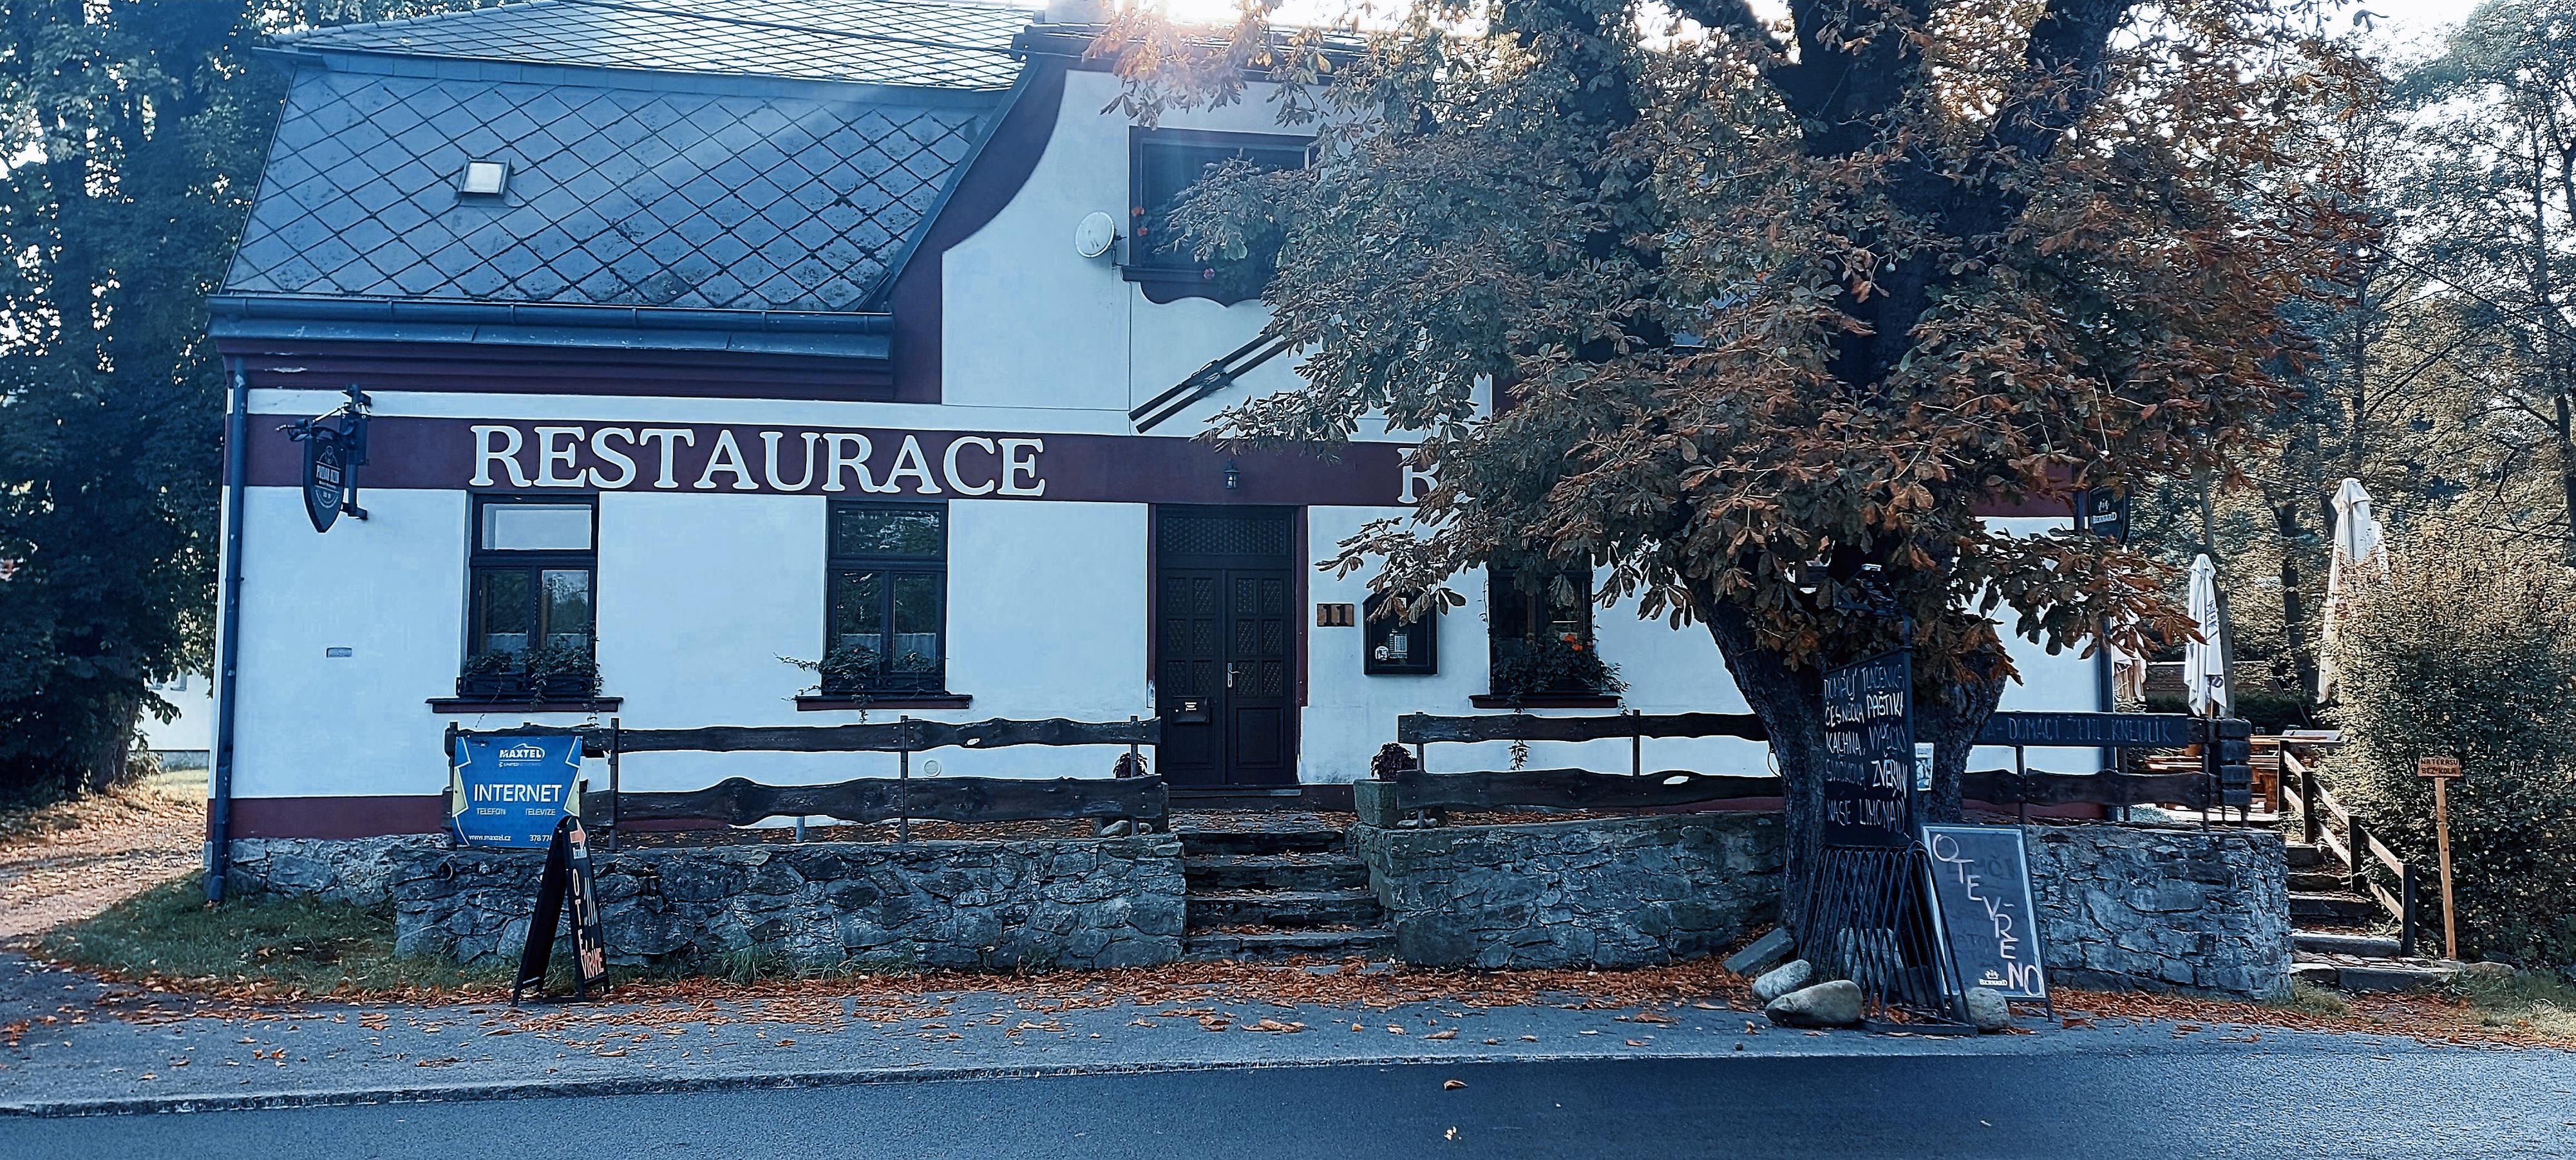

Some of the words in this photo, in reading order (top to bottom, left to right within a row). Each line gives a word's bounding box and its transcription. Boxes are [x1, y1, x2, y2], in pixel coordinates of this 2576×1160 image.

[469, 425, 1045, 497] RESTAURACE
[2092, 512, 2117, 524] BERNARD
[499, 749, 542, 758] MAXTEL
[474, 783, 562, 803] INTERNET
[477, 807, 506, 816] TELEFON
